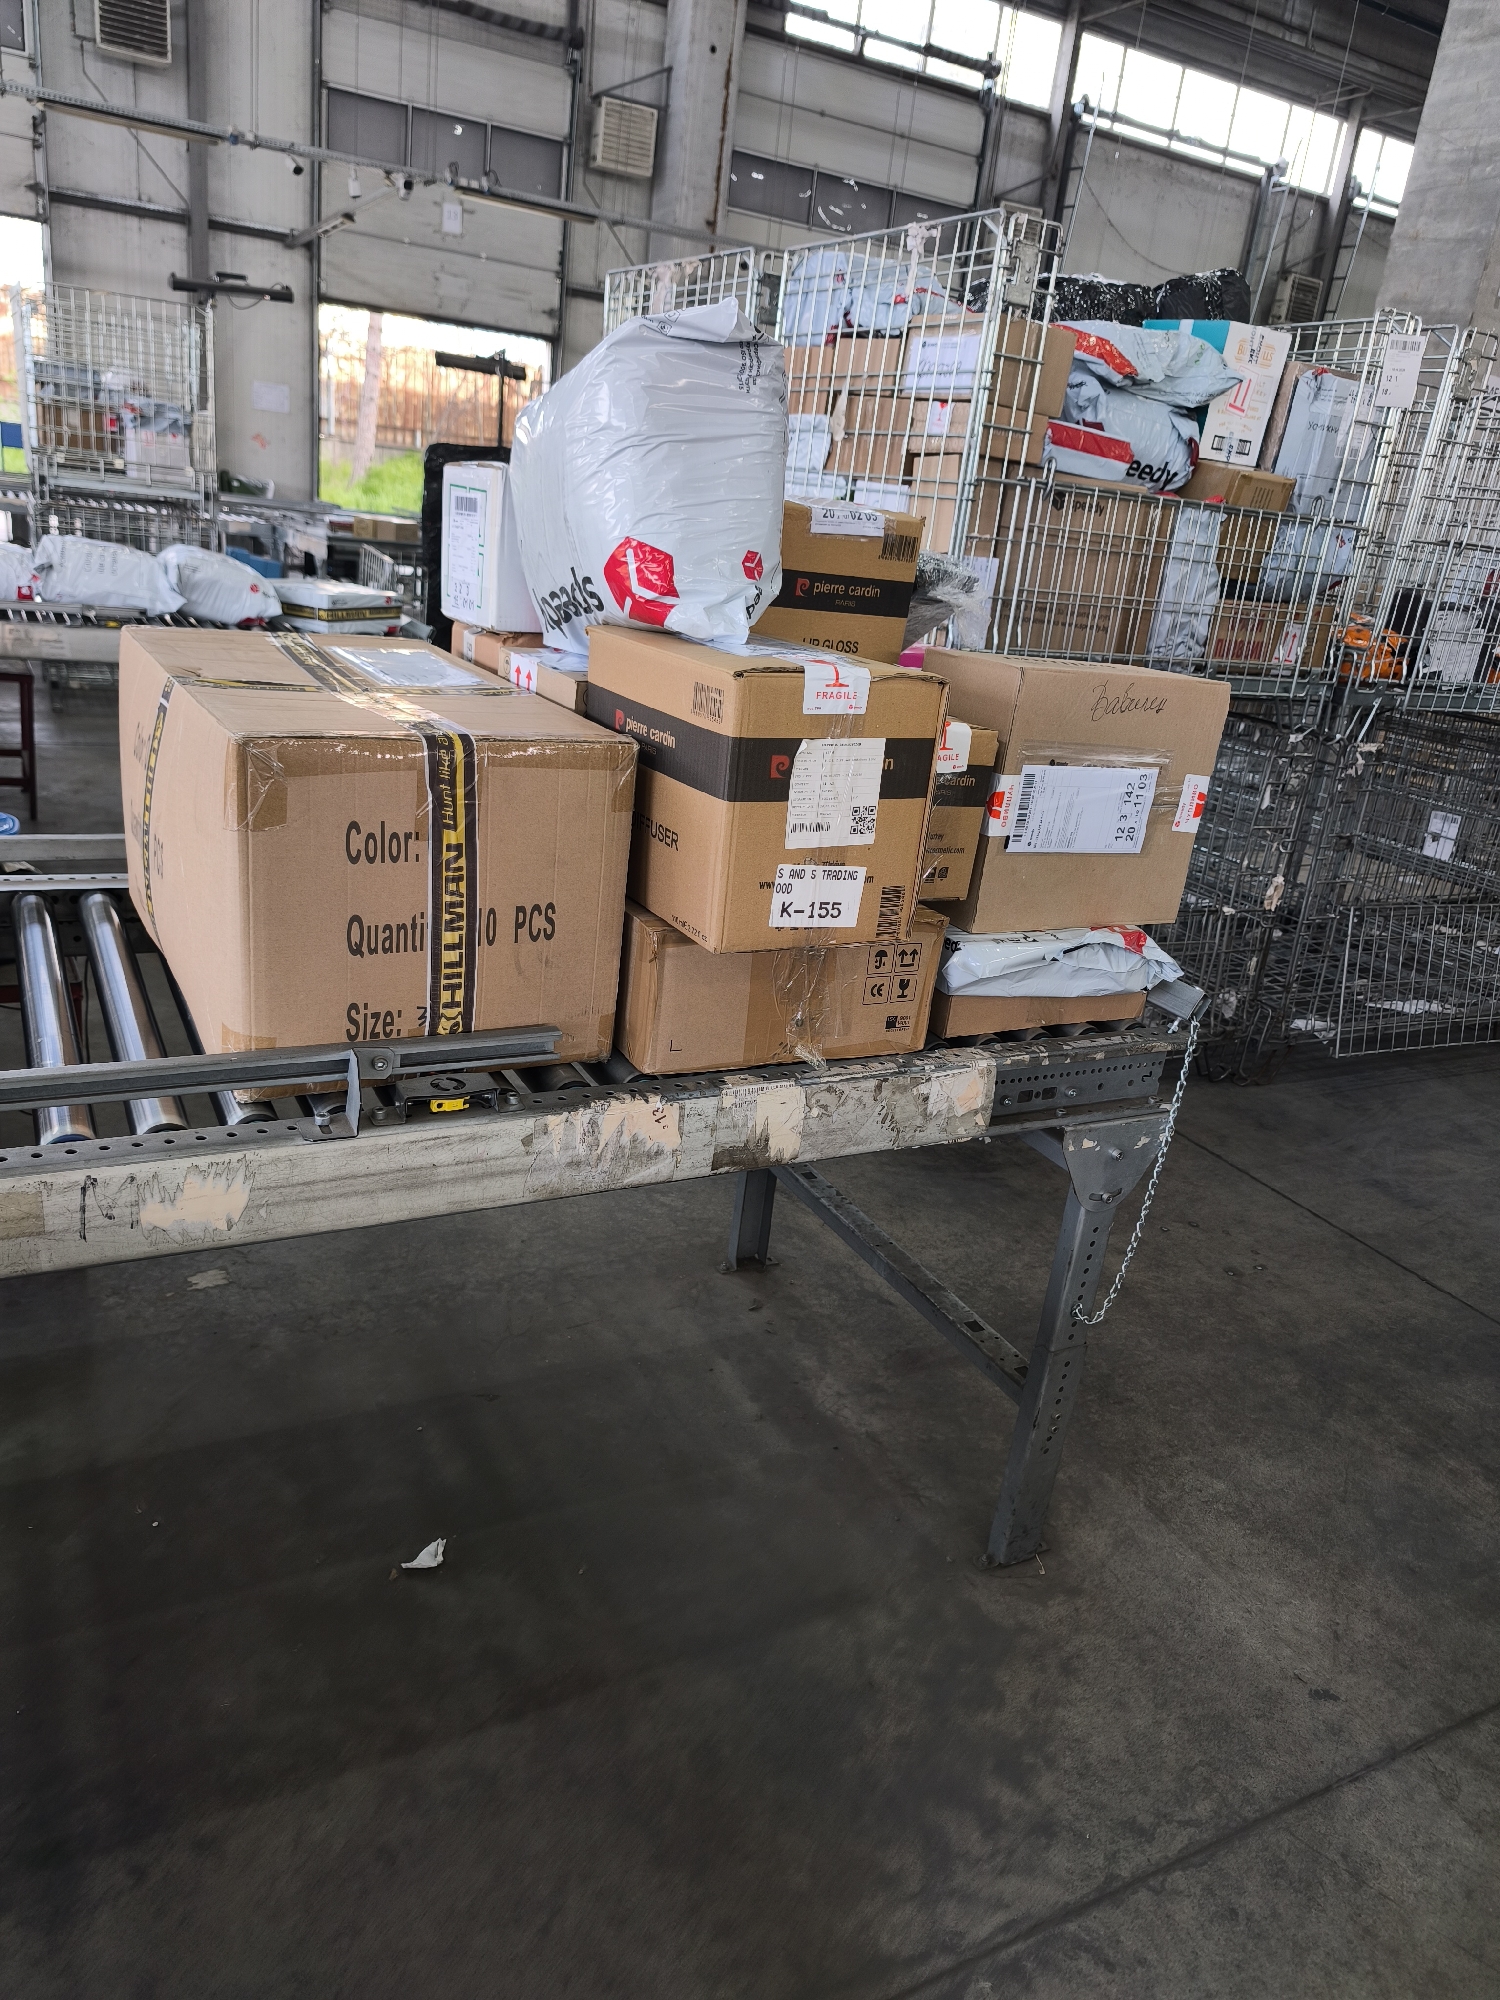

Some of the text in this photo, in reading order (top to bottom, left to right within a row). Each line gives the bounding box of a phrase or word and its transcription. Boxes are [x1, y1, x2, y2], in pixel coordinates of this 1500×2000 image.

[1125, 459, 1179, 491] eedy
[1072, 497, 1105, 517] peedy
[813, 580, 881, 598] pierre cardin
[834, 599, 856, 608] PARIS
[802, 637, 820, 648] IP
[815, 690, 858, 700] FRAGILE
[625, 715, 676, 749] pierre cardin
[641, 742, 657, 755] PARIS
[937, 753, 960, 762] AGILE
[438, 749, 451, 781] like
[1137, 773, 1148, 790] 03
[440, 783, 454, 825] Hunt
[1000, 784, 1015, 828] ЧУПЛИВО
[1133, 794, 1144, 808] 11
[1184, 783, 1199, 824] ЧУПЛИВО
[1114, 782, 1136, 842] 12 3 142
[345, 820, 420, 865] Color:
[1125, 826, 1136, 842] 20
[777, 867, 859, 881] S AND S TRADING
[775, 882, 793, 895] OOD
[779, 901, 842, 919] K-155
[346, 911, 428, 959] Quanti
[513, 901, 557, 944] PCS
[441, 842, 466, 1011] HILLMAN
[345, 1002, 403, 1042] Size:
